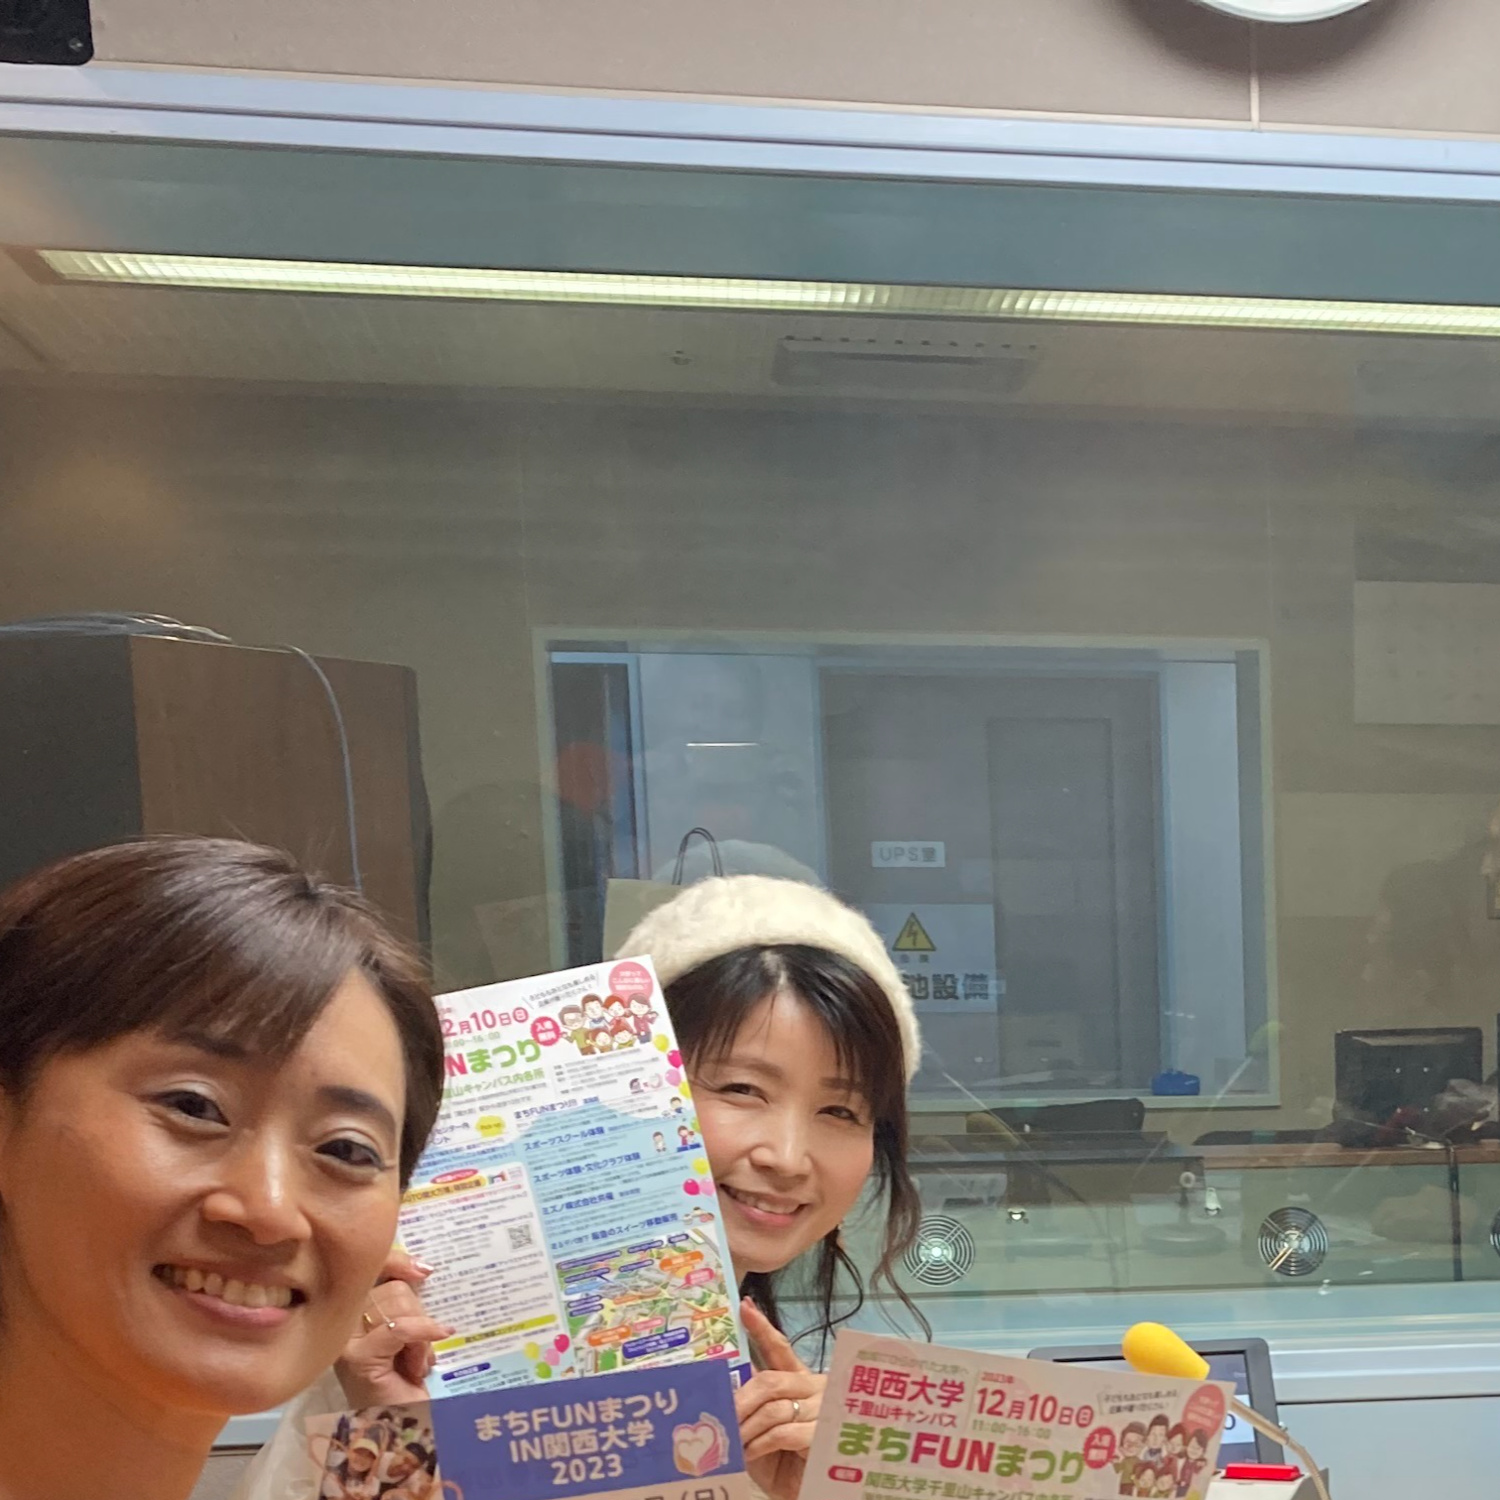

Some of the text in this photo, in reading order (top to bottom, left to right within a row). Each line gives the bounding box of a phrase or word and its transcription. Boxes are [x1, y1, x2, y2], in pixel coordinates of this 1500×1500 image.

[848, 1364, 966, 1408] 関西大学
[474, 1388, 679, 1442] まちFUNまつり
[844, 1398, 958, 1429] 千里山キャンパス
[509, 1420, 656, 1463] IN関西大学
[837, 1421, 1086, 1484] まちFUNまつり
[551, 1453, 624, 1485] 2023
